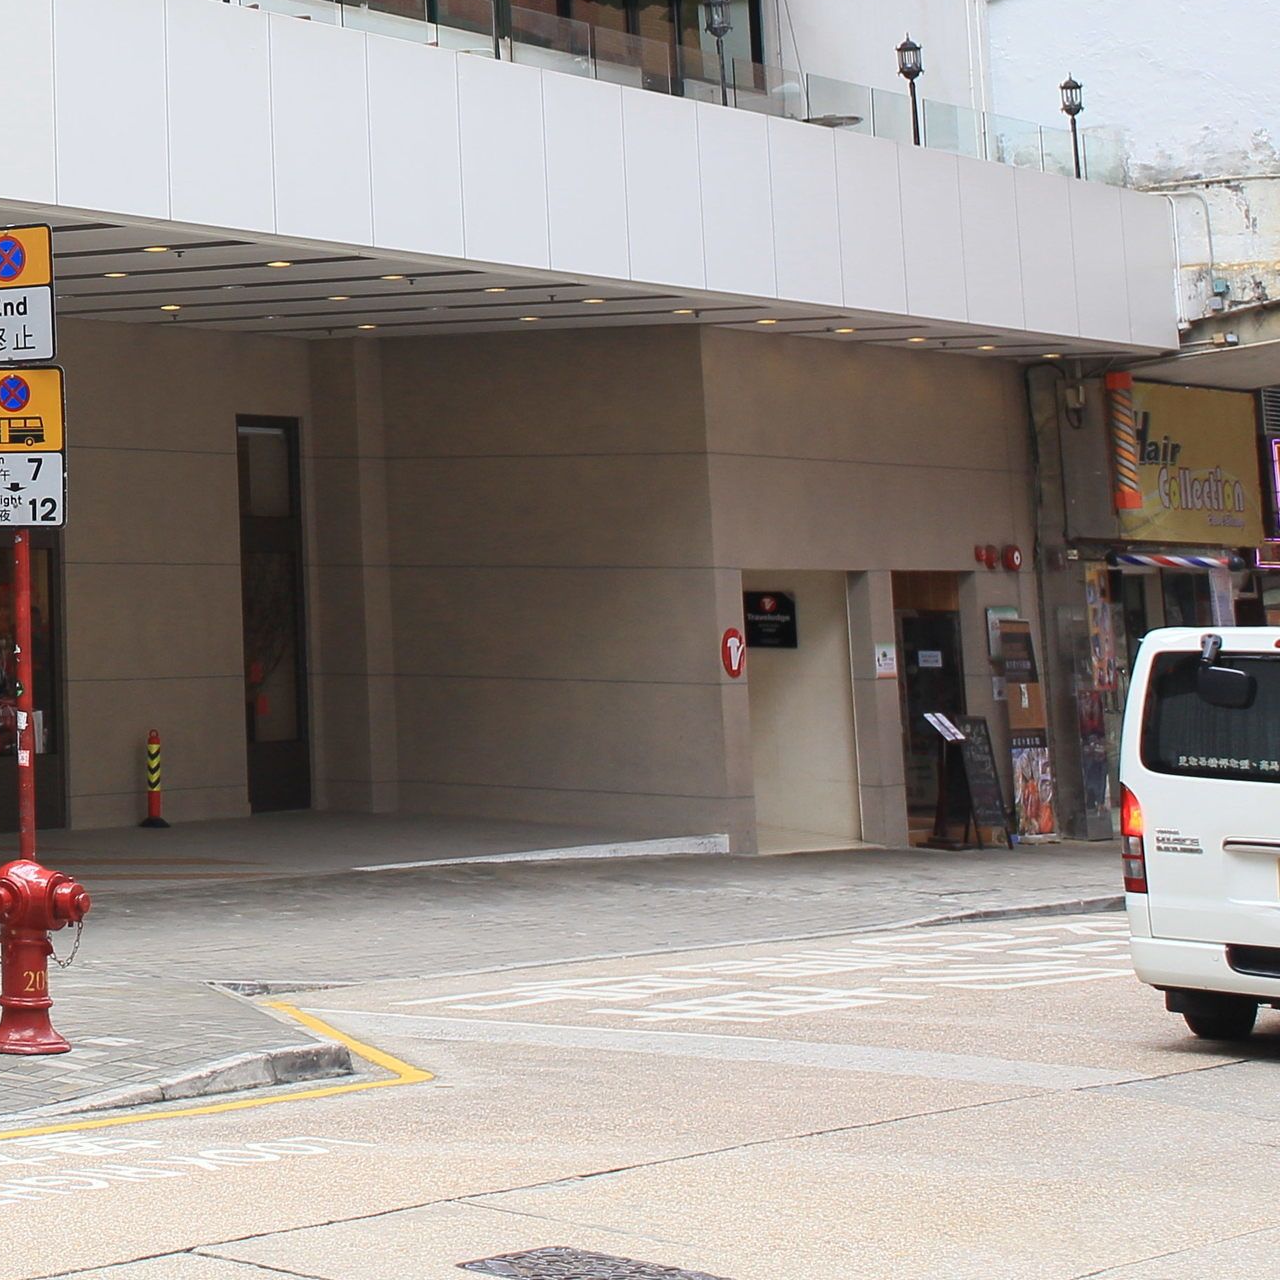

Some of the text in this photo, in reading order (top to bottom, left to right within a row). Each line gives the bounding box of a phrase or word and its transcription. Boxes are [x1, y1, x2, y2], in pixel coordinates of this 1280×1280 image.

[27, 457, 43, 481] 7
[1158, 466, 1245, 512] Collection
[28, 497, 57, 522] 12
[141, 1135, 377, 1171] LOOK
